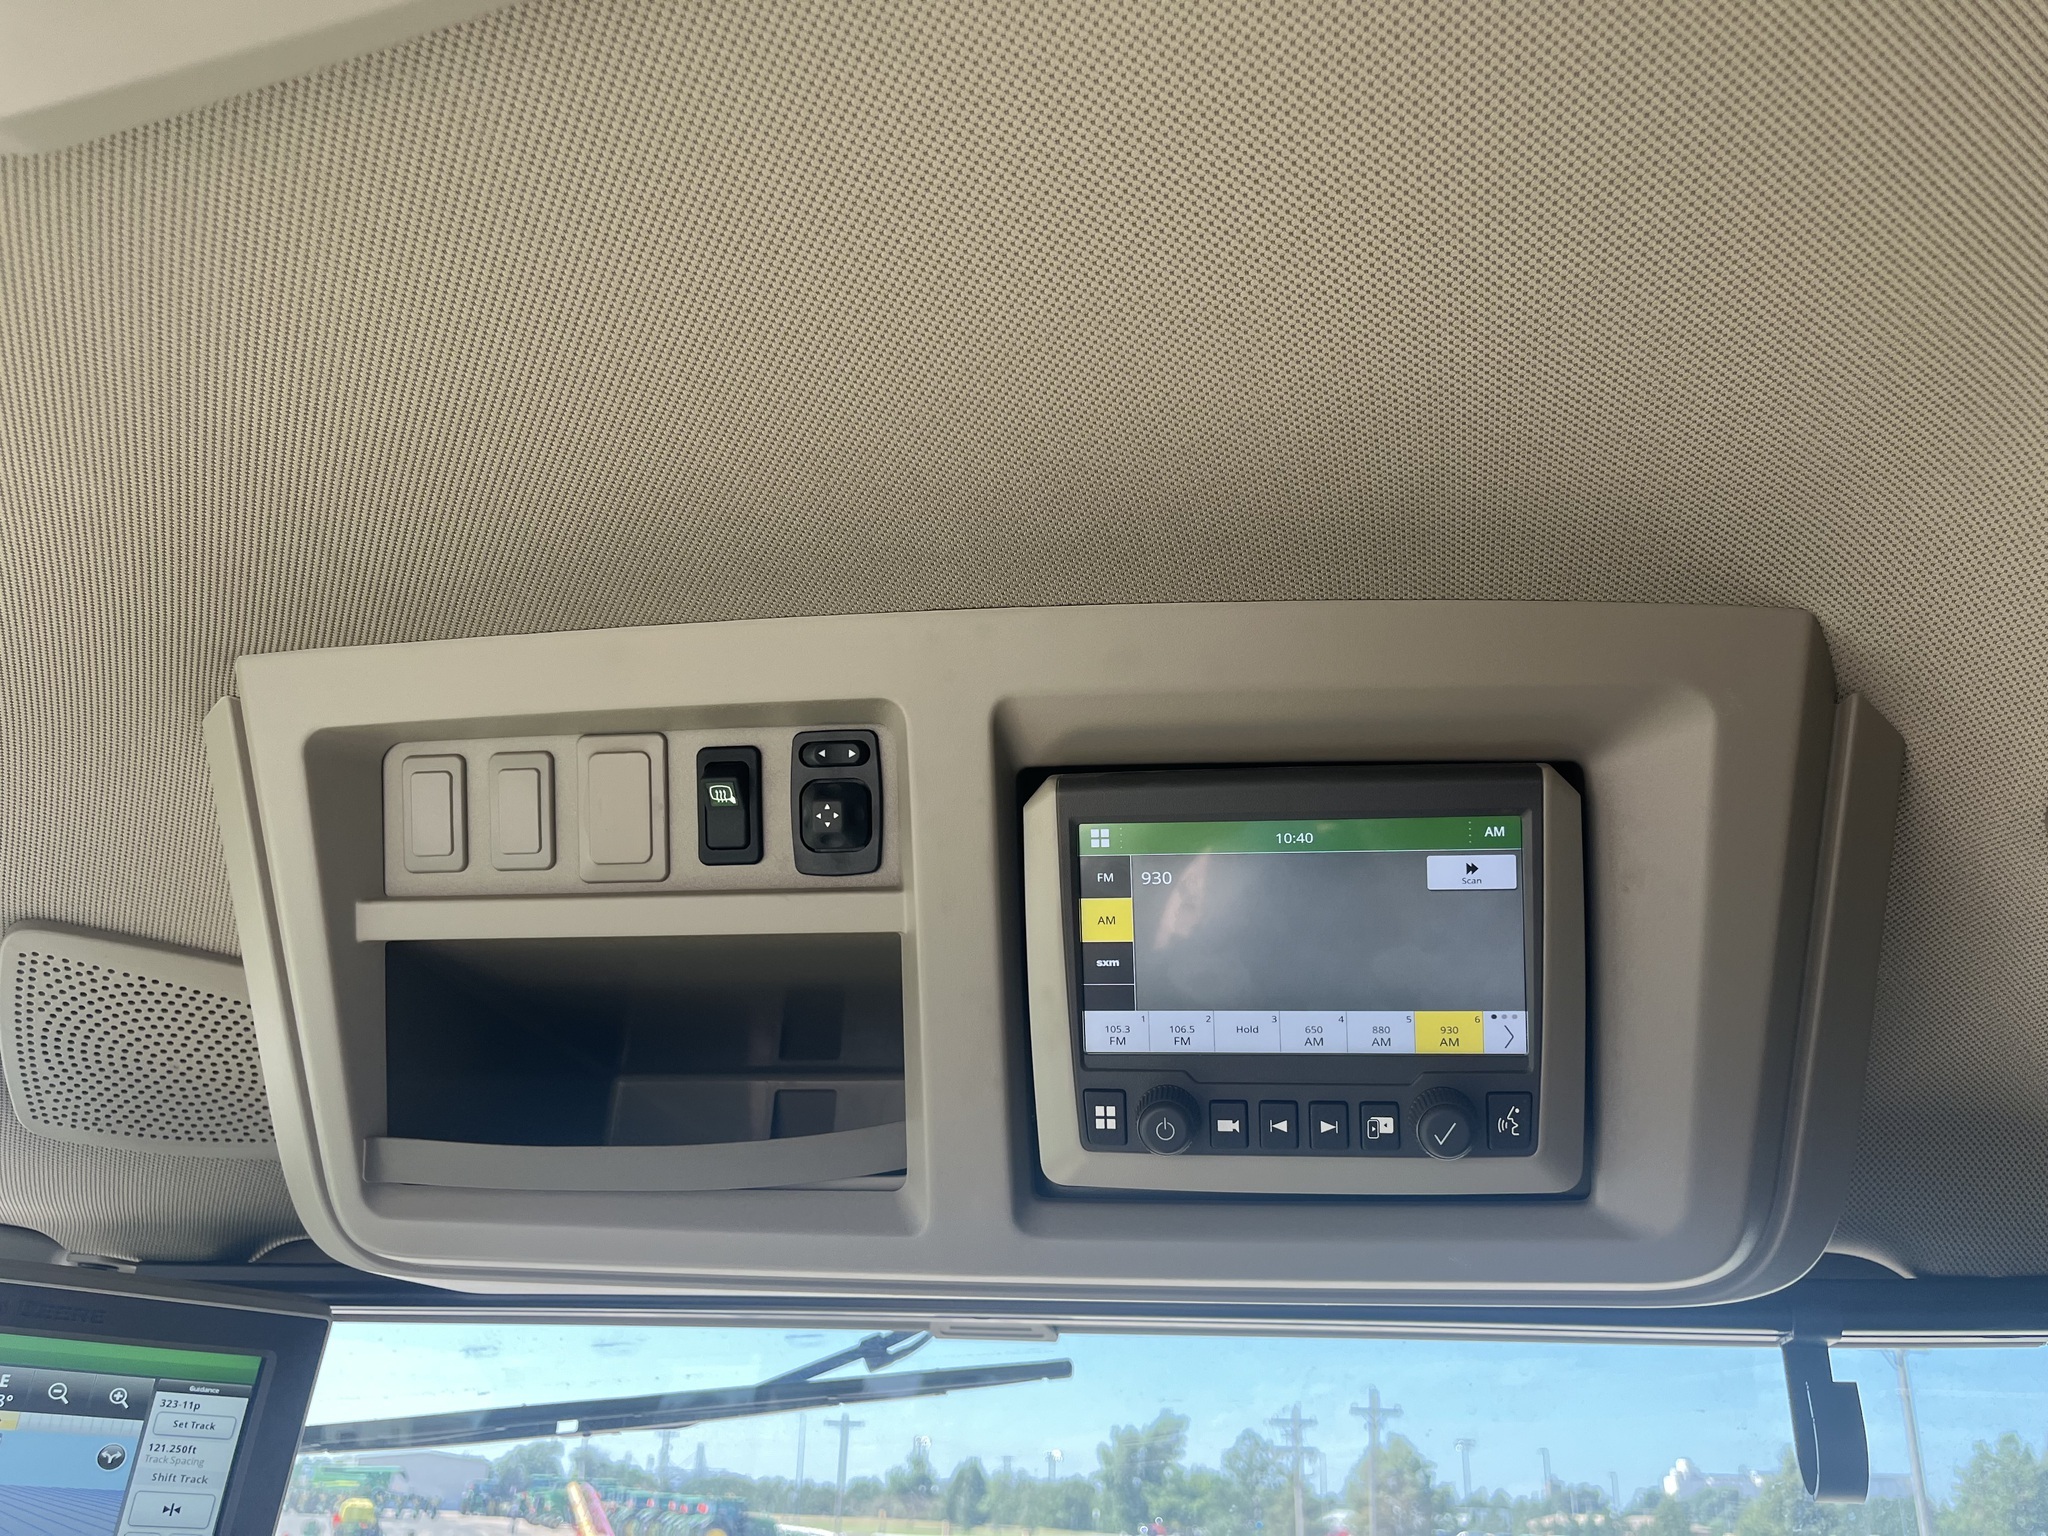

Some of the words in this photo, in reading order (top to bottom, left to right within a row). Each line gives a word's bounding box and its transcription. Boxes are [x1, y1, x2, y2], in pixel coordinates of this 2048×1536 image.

[1484, 826, 1506, 838] AM
[1275, 832, 1314, 844] 10:40
[1096, 872, 1115, 883] FM
[1141, 871, 1173, 886] 930
[1461, 876, 1483, 886] Scan
[1097, 915, 1117, 926] AM
[1095, 958, 1120, 968] sxm
[1141, 1015, 1146, 1023] 1
[1205, 1015, 1212, 1023] 2
[1272, 1015, 1278, 1024] 3
[1338, 1015, 1345, 1024] 4
[1406, 1015, 1412, 1024] 5
[1474, 1015, 1481, 1024] 6
[1104, 1024, 1131, 1035] 105.3
[1169, 1024, 1195, 1035] 106.5
[1235, 1024, 1260, 1035] Hold
[1304, 1025, 1324, 1035] 650
[1371, 1025, 1391, 1035] 880
[1440, 1025, 1460, 1035] 930
[1109, 1036, 1127, 1047] FM
[1173, 1036, 1192, 1047] FM
[1304, 1036, 1325, 1048] AM
[1371, 1036, 1392, 1048] AM
[1439, 1037, 1461, 1048] AM
[189, 1385, 220, 1394] Guidance
[159, 1399, 201, 1411] 323-11p
[172, 1419, 189, 1429] Set
[191, 1421, 216, 1431] Track
[149, 1443, 197, 1454] 121.250ft
[145, 1454, 169, 1464] Track
[171, 1456, 205, 1468] Spacing
[151, 1472, 177, 1483] Shift
[179, 1474, 209, 1485] Track
